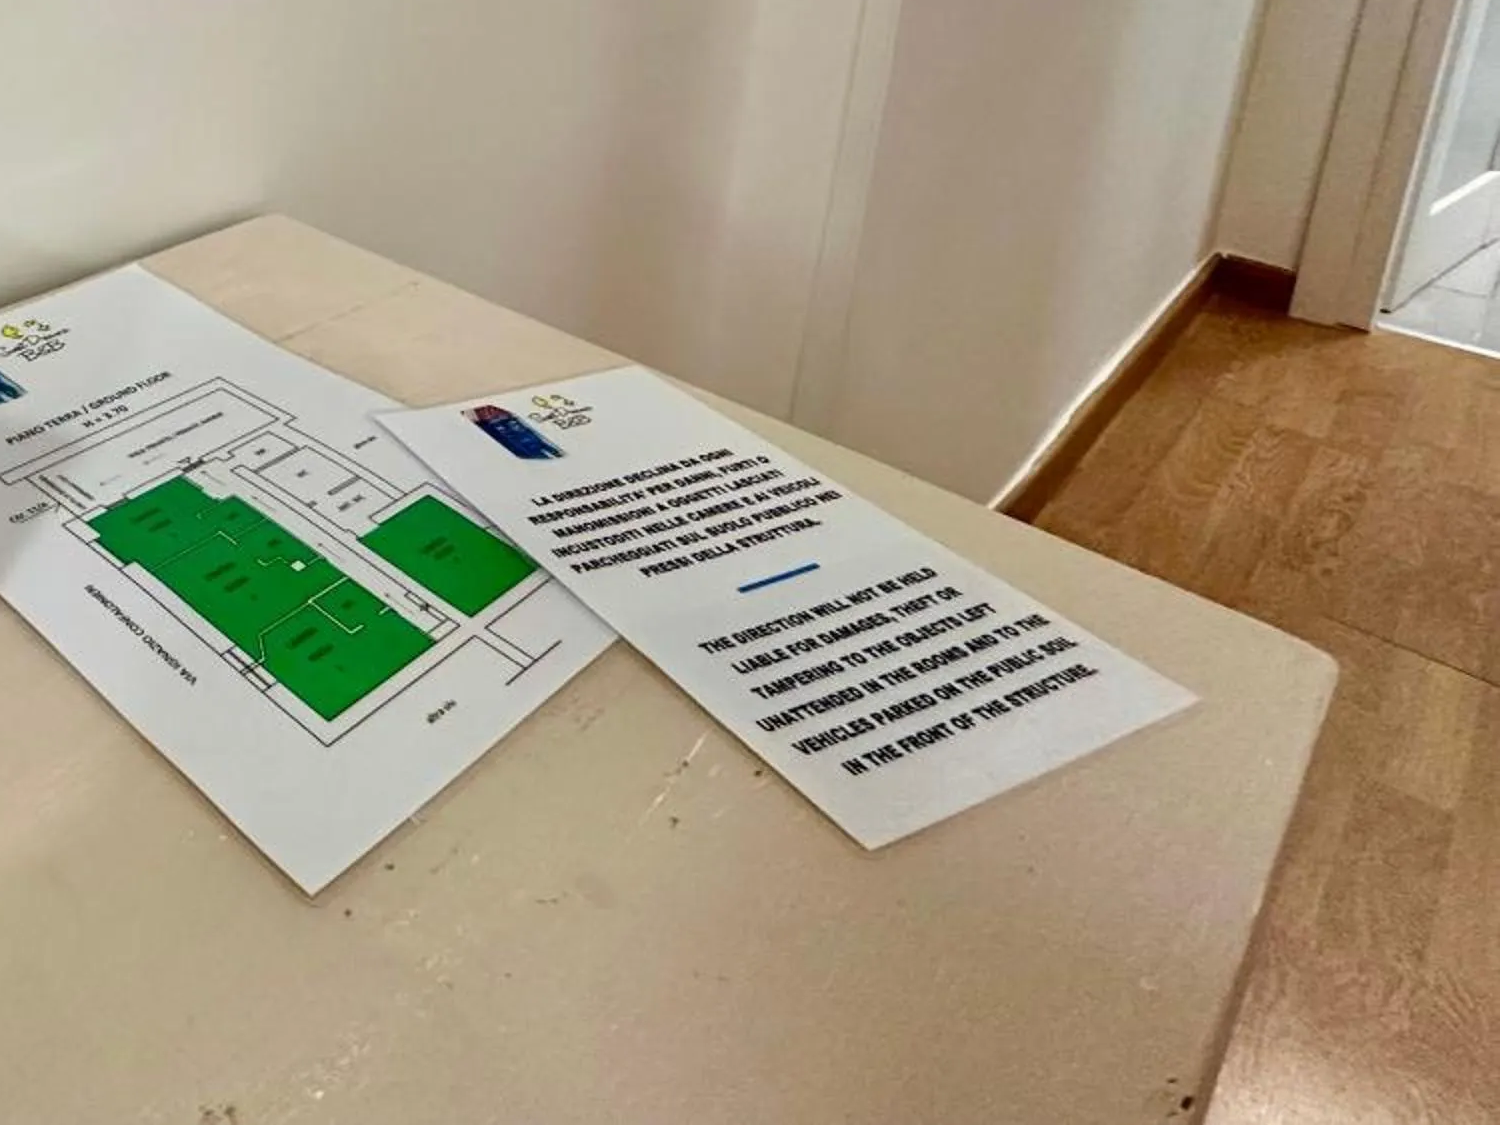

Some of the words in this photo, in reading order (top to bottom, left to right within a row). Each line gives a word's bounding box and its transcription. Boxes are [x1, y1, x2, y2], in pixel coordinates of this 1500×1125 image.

[4, 424, 46, 445] PIANO
[43, 410, 82, 428] TERRA
[88, 386, 137, 409] GROUND
[530, 496, 554, 507] LA
[551, 477, 626, 502] DIREZIONE
[622, 462, 682, 484] DECLINA
[678, 457, 701, 468] DA
[551, 528, 644, 558] INCUSTODITI
[640, 515, 689, 535] NELLE
[686, 499, 744, 521] CAMERE
[739, 495, 755, 506] E
[753, 491, 771, 502] AI
[766, 476, 820, 497] VEICOLI
[552, 506, 656, 538] MANOMISSIONI
[655, 502, 669, 512] A
[666, 485, 727, 508] OGGETTI
[723, 468, 783, 491] LASCIATI
[645, 481, 676, 495] PER
[717, 458, 758, 474] FURTI
[570, 539, 677, 573] PARCHEGGIATI
[675, 531, 708, 546] SUL
[704, 516, 753, 537] SUOLO
[750, 497, 818, 522] PUBBLICO
[814, 489, 842, 503] NEI
[639, 555, 694, 577] PRESSI
[690, 542, 740, 562] DELLA
[697, 635, 736, 654] THE
[731, 610, 815, 644] DIRECTION
[808, 599, 851, 617] WILL
[845, 586, 880, 605] NOT
[875, 579, 903, 594] BE
[896, 567, 937, 586] HELD
[731, 648, 791, 674] LIABLE
[785, 637, 823, 656] FOR
[816, 612, 898, 644] DAMAGES,
[888, 593, 938, 617] THEFT
[935, 586, 963, 601] OR
[750, 660, 844, 699] TAMPERING
[839, 651, 868, 667] TO
[861, 639, 900, 658] THE
[894, 615, 963, 647] OBJECTS
[956, 602, 996, 622] LEFT
[755, 686, 864, 732] UNATTENDED
[858, 678, 885, 694] IN
[877, 665, 917, 686] THE
[910, 645, 969, 673] ROOMS
[963, 633, 999, 653] AND
[991, 625, 1020, 639] TO
[1013, 613, 1050, 631] THE
[791, 717, 876, 755] VEHICLES
[869, 693, 937, 725] PARKED
[932, 682, 963, 700] ON
[954, 669, 994, 690] THE
[986, 648, 1044, 677] PUBLIC
[1037, 636, 1078, 655] SOIL
[840, 757, 869, 776] IN
[860, 743, 904, 766] THE
[896, 722, 954, 753] FRONT
[949, 712, 976, 730] OF
[970, 699, 1011, 720] THE
